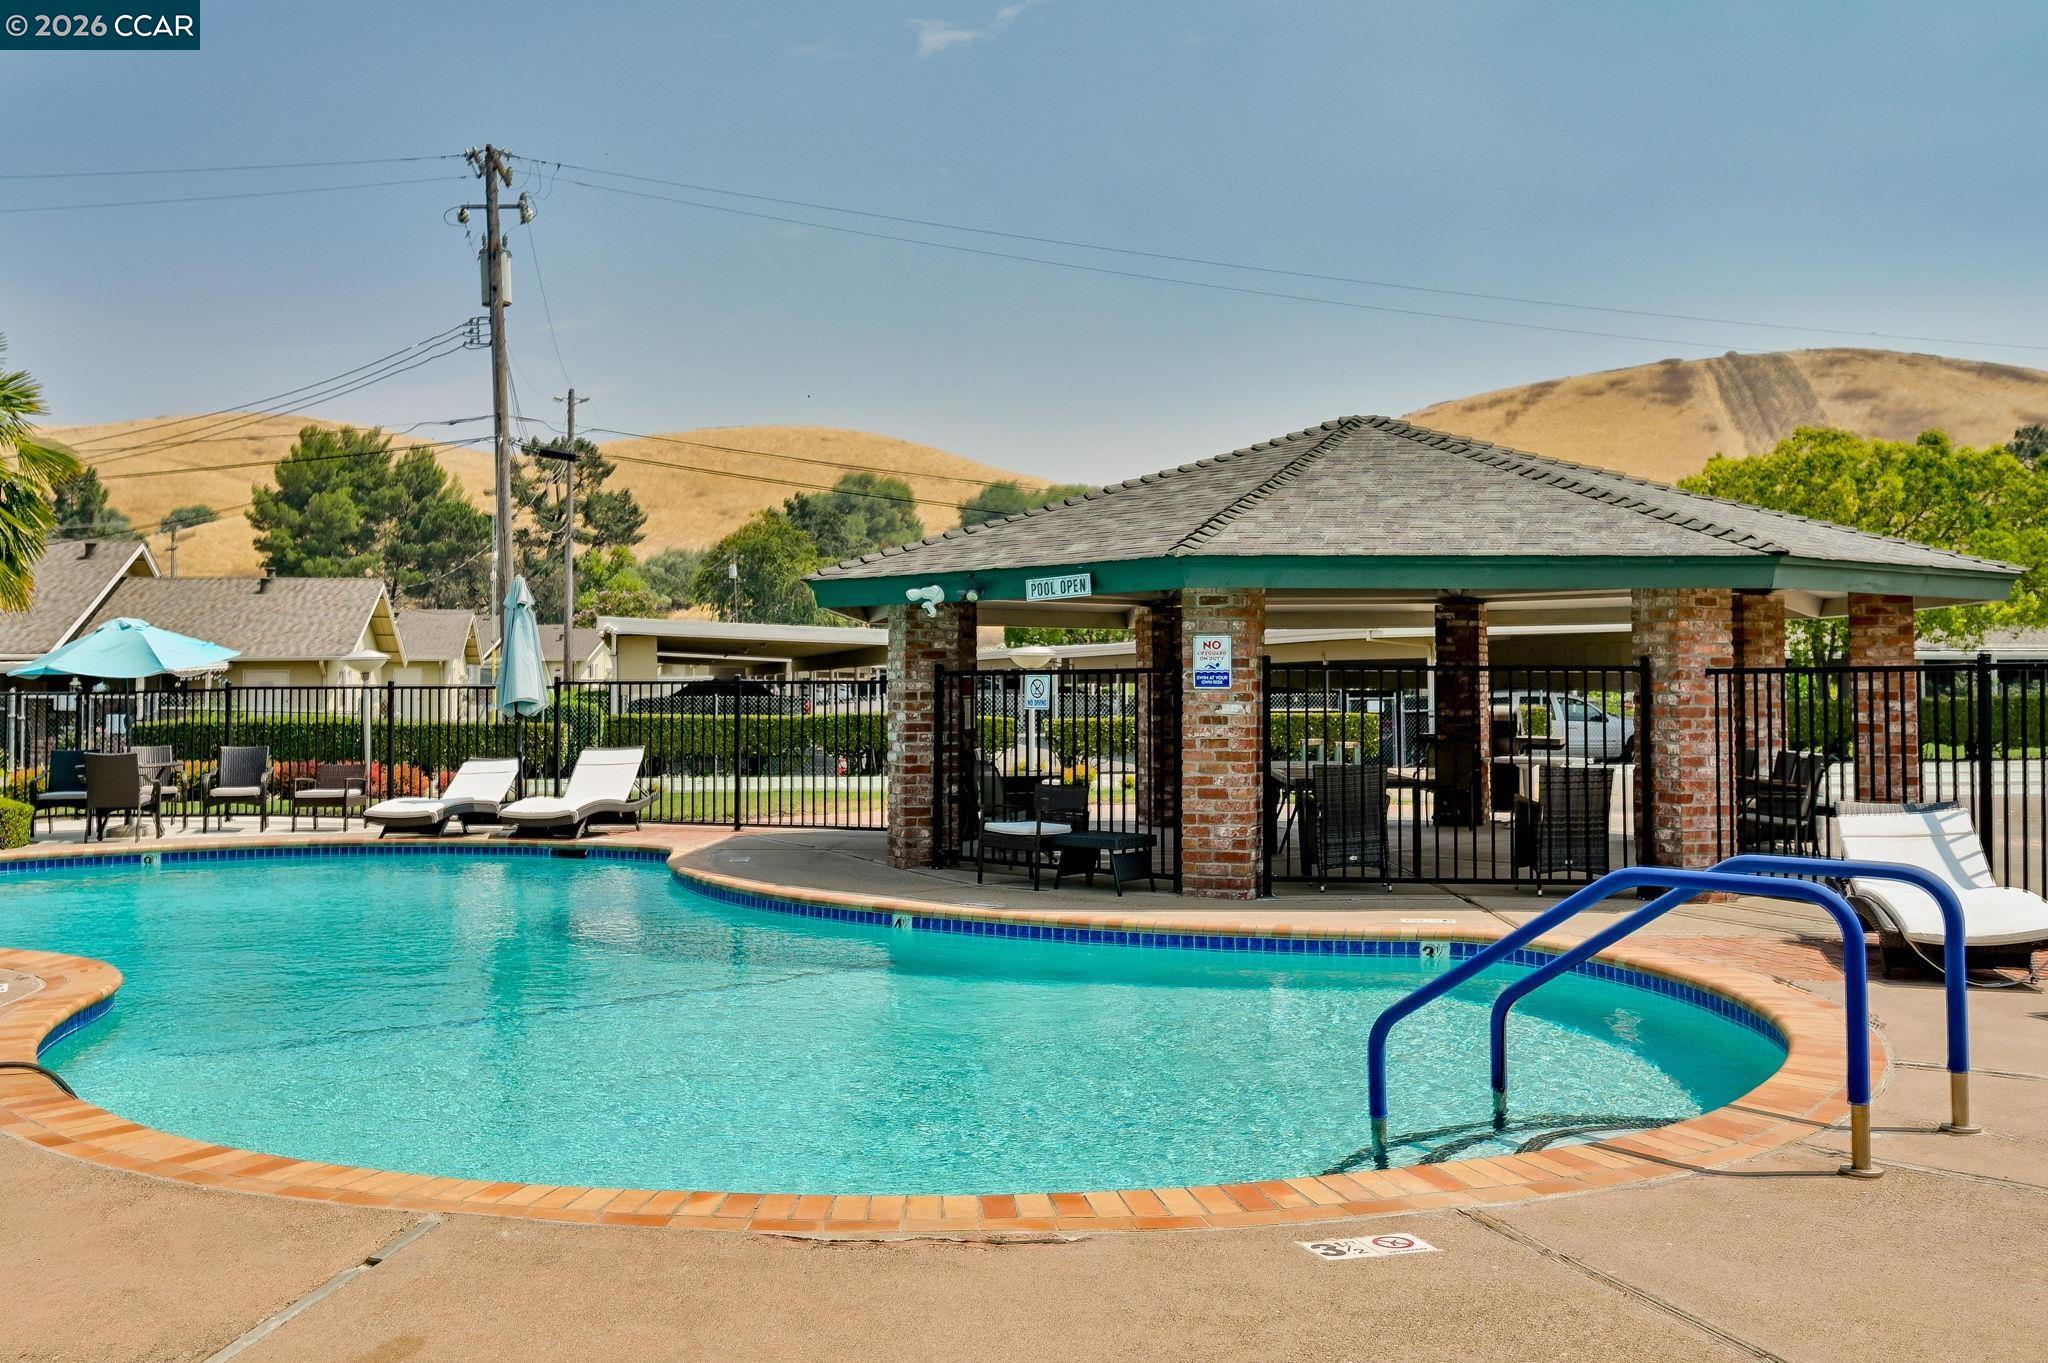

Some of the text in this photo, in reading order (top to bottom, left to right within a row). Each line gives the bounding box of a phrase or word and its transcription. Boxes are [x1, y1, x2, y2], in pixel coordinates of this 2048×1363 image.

[1031, 578, 1086, 597] POOL OPEN
[1203, 640, 1222, 649] NO
